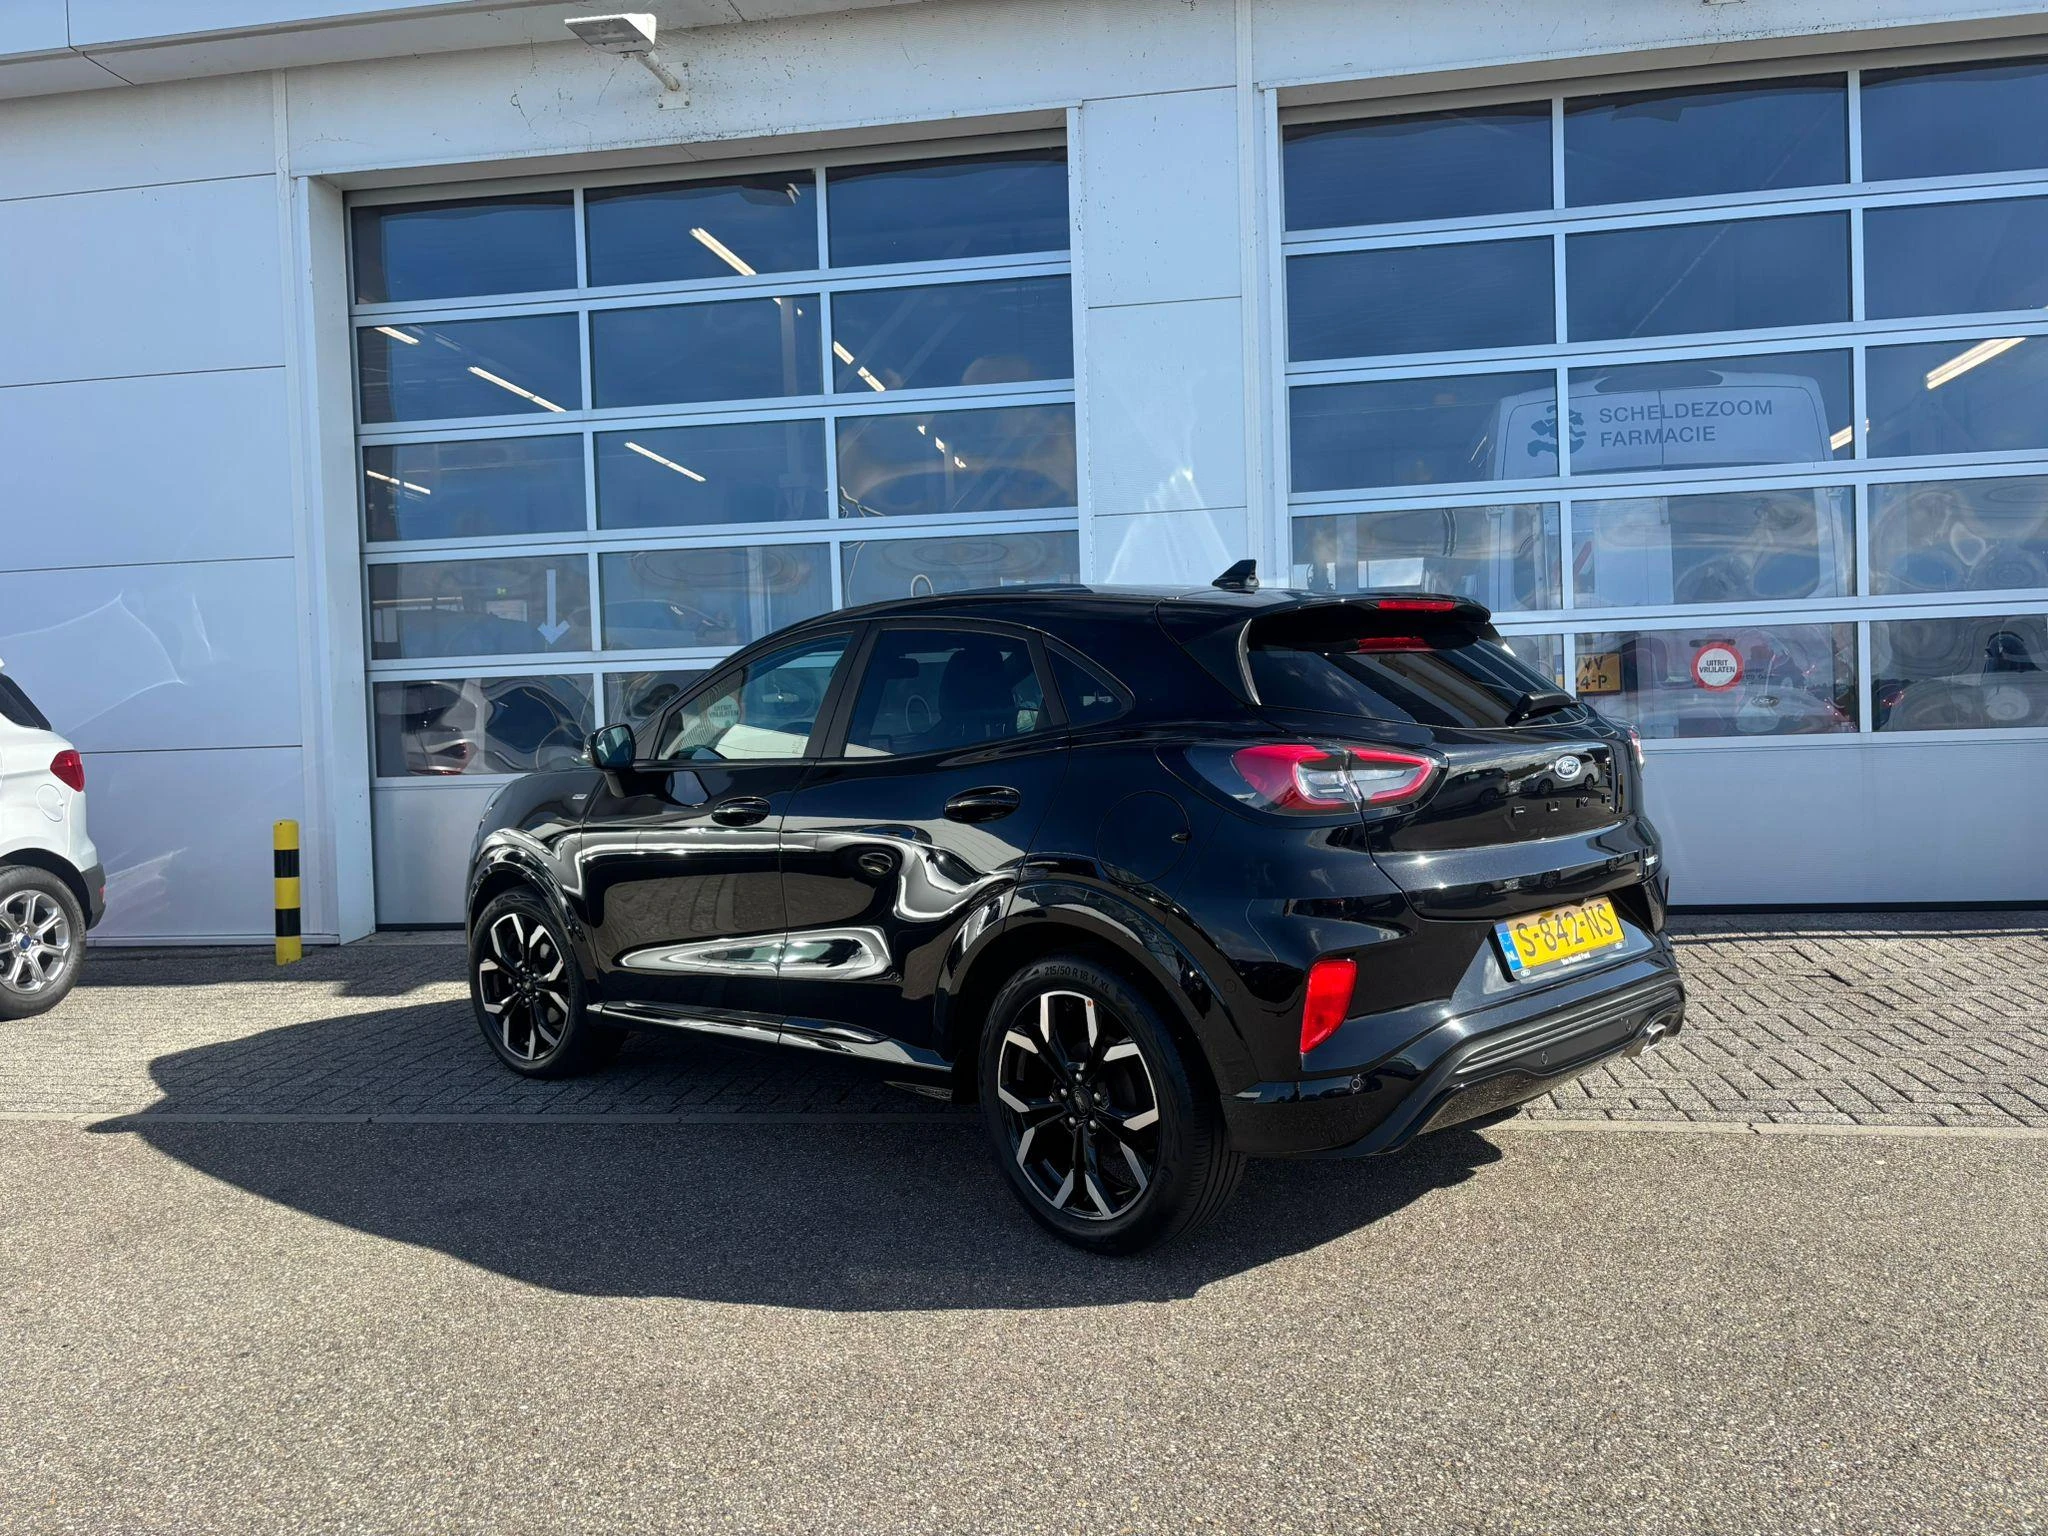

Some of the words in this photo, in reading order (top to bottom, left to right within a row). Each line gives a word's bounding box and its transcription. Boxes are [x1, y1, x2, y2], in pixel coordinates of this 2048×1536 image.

[1599, 399, 1773, 424] SCHELDEZOOM
[1600, 426, 1716, 448] FARMACIE
[1699, 665, 1736, 674] VRIJLATEN
[1516, 903, 1615, 957] S-842-NS
[1506, 950, 1518, 961] NL
[1044, 965, 1071, 977] 215/50
[1072, 967, 1078, 977] R
[1079, 970, 1089, 980] 18
